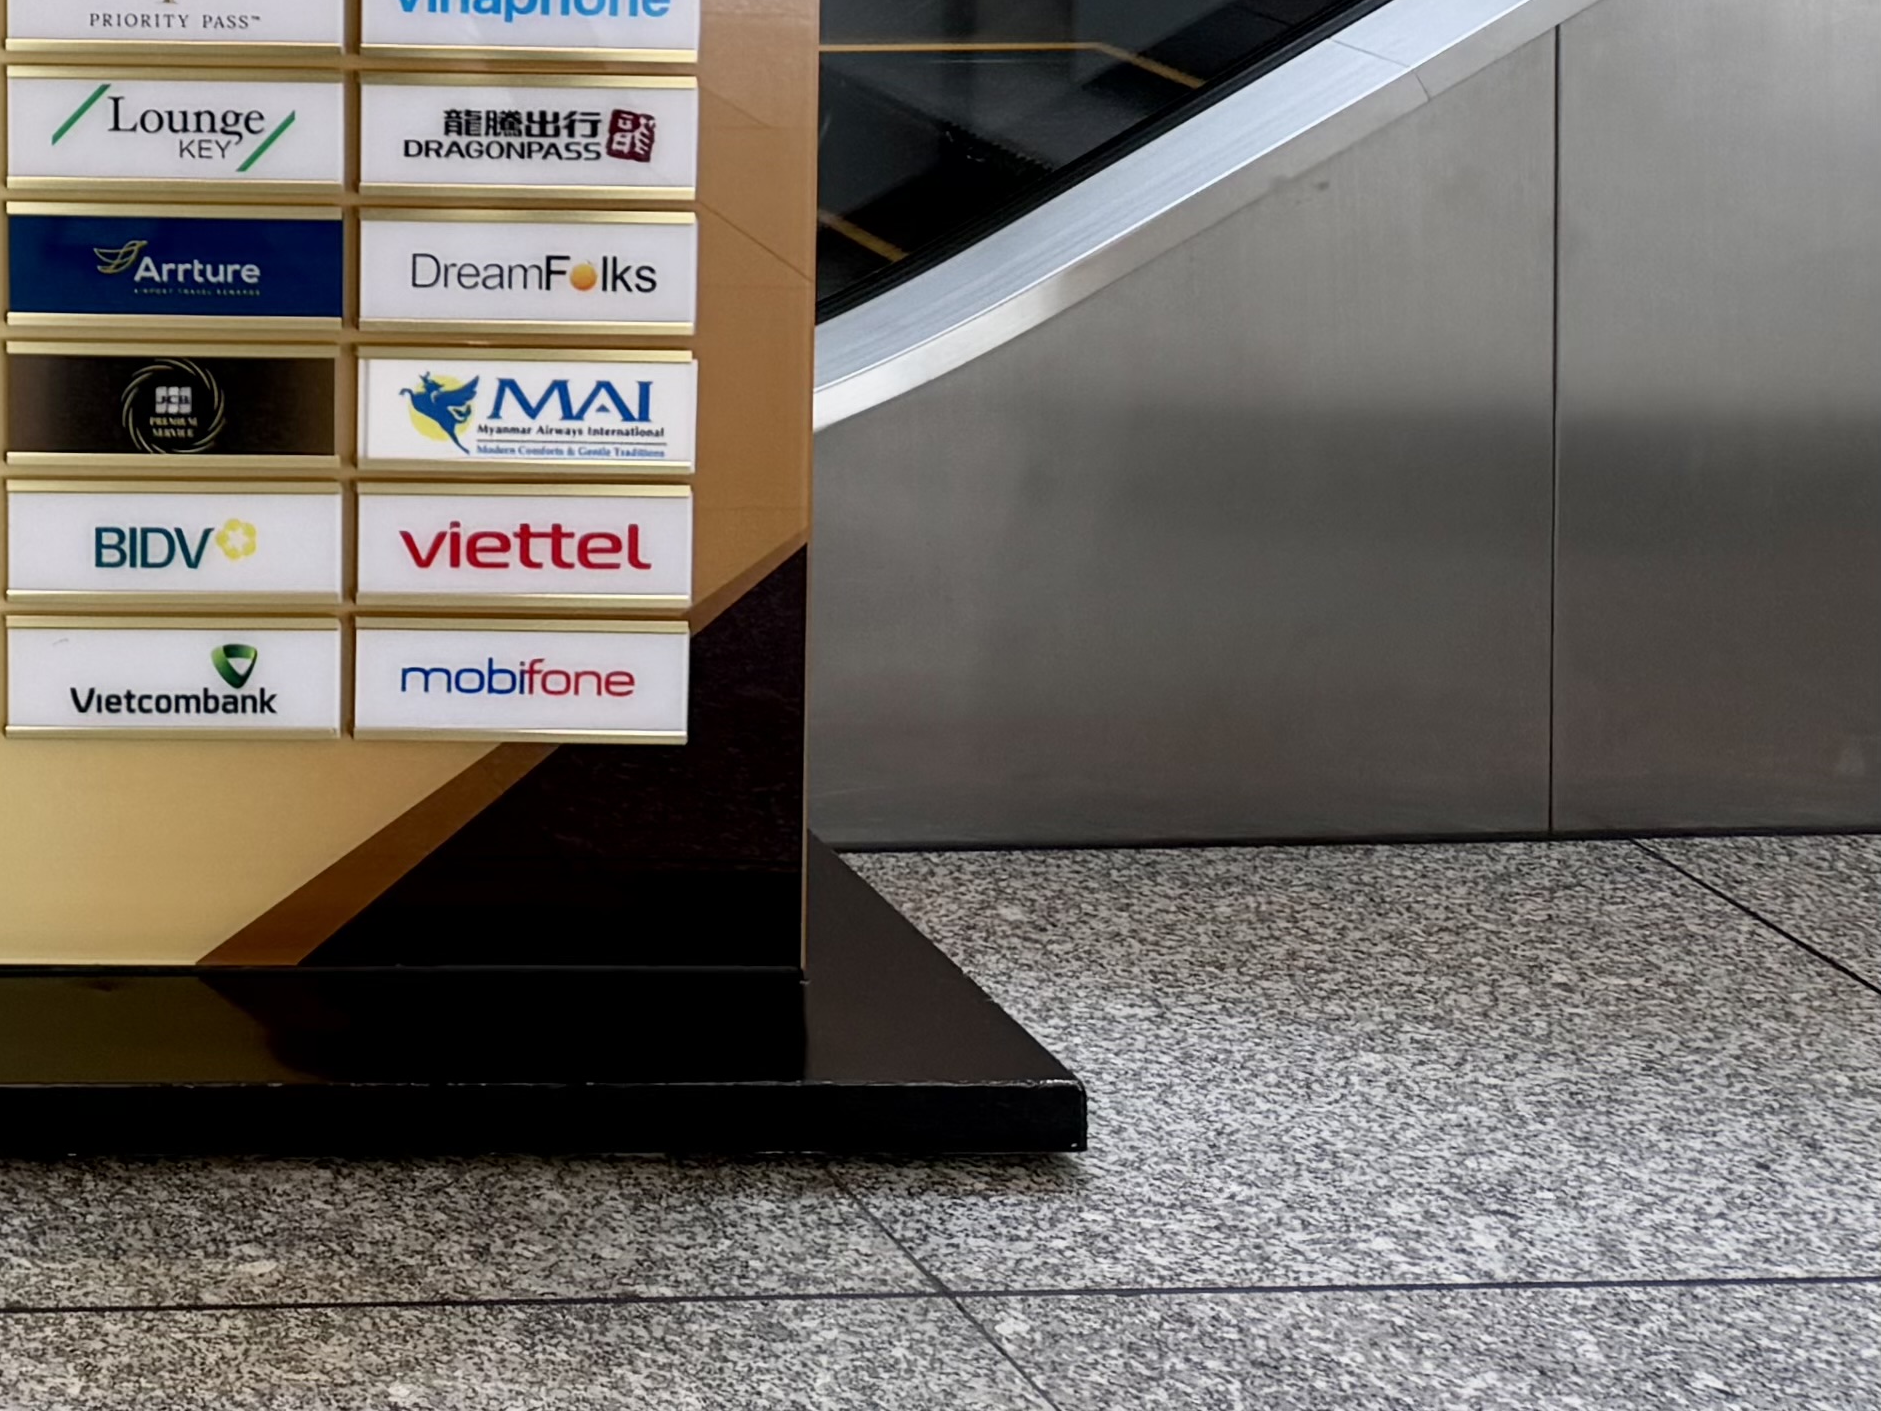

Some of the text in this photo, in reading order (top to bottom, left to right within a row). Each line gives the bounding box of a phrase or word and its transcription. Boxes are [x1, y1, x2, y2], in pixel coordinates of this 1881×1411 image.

[89, 13, 190, 28] PRIORITY
[107, 96, 265, 146] Lounge
[179, 140, 232, 159] KEY
[404, 139, 602, 161] DRAGONPASS
[134, 256, 261, 284] Arrture
[411, 253, 657, 293] DreamFolks
[487, 378, 653, 423] MAI
[477, 424, 664, 438] Myanmar Airways International
[94, 527, 215, 569] BIDV
[399, 521, 652, 570] viettel
[401, 658, 635, 697] mobifone
[70, 688, 277, 715] Vietcombank
